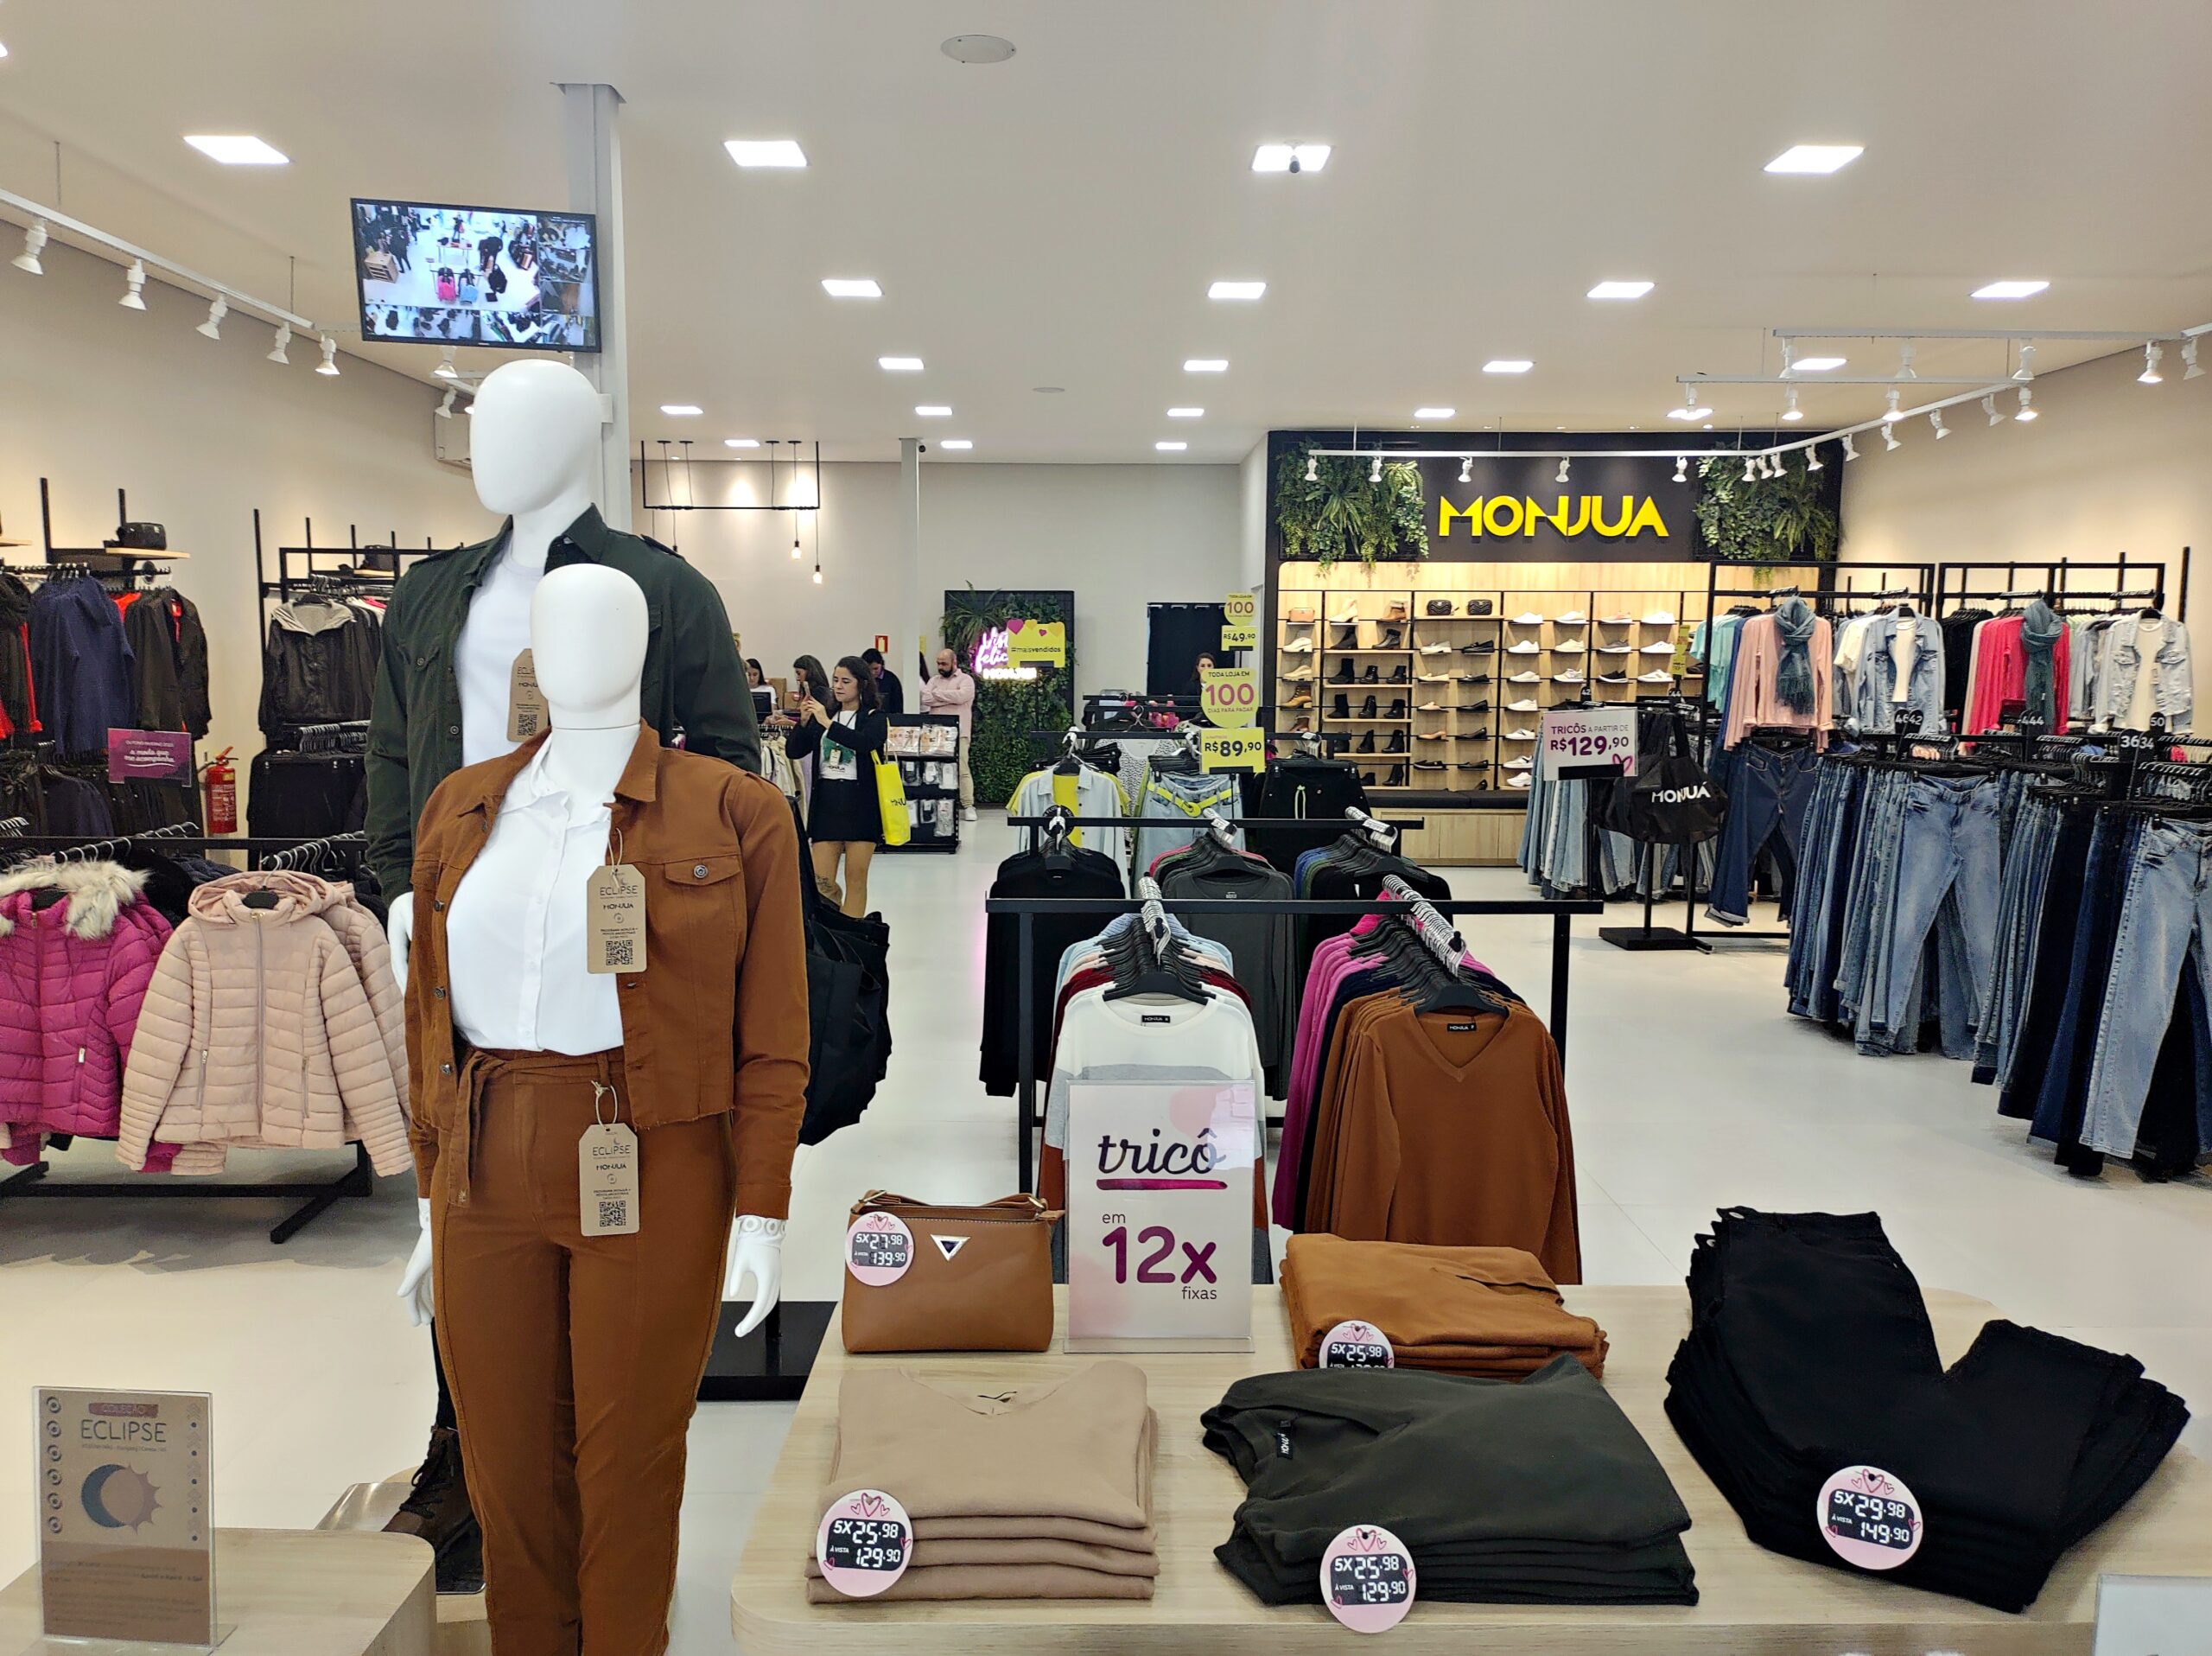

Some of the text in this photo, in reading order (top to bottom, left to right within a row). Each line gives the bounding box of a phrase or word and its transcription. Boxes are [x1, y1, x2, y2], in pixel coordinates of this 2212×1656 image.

[1439, 495, 1669, 537] MONJUA
[1227, 602, 1254, 614] 100
[1205, 683, 1255, 705] 100
[1909, 715, 1922, 724] 42
[2030, 716, 2044, 725] 44
[2150, 717, 2165, 726] 50
[1551, 723, 1586, 735] TRICÔS
[1205, 740, 1262, 757] R$89,90
[1550, 736, 1629, 755] R$129,90
[2120, 736, 2154, 749] 36 34
[600, 885, 638, 895] ECLIPSE
[592, 1144, 631, 1156] ECLIPSE
[1097, 1127, 1227, 1174] tricô
[1102, 1213, 1126, 1224] em
[855, 1233, 903, 1250] 5X 27.98
[873, 1251, 906, 1265] 139.90
[1102, 1226, 1217, 1284] 12x
[1182, 1286, 1217, 1300] fixas
[1332, 1344, 1382, 1362] 5X 25.98
[81, 1419, 167, 1443] ECLIPSE
[1834, 1491, 1906, 1521] 5X 29.98
[833, 1520, 899, 1545] 5X 25.98
[1860, 1522, 1910, 1545] 149.90
[855, 1547, 900, 1568] 129.90
[1334, 1556, 1400, 1580] 5X 25.98
[1362, 1581, 1406, 1602] 129.90
